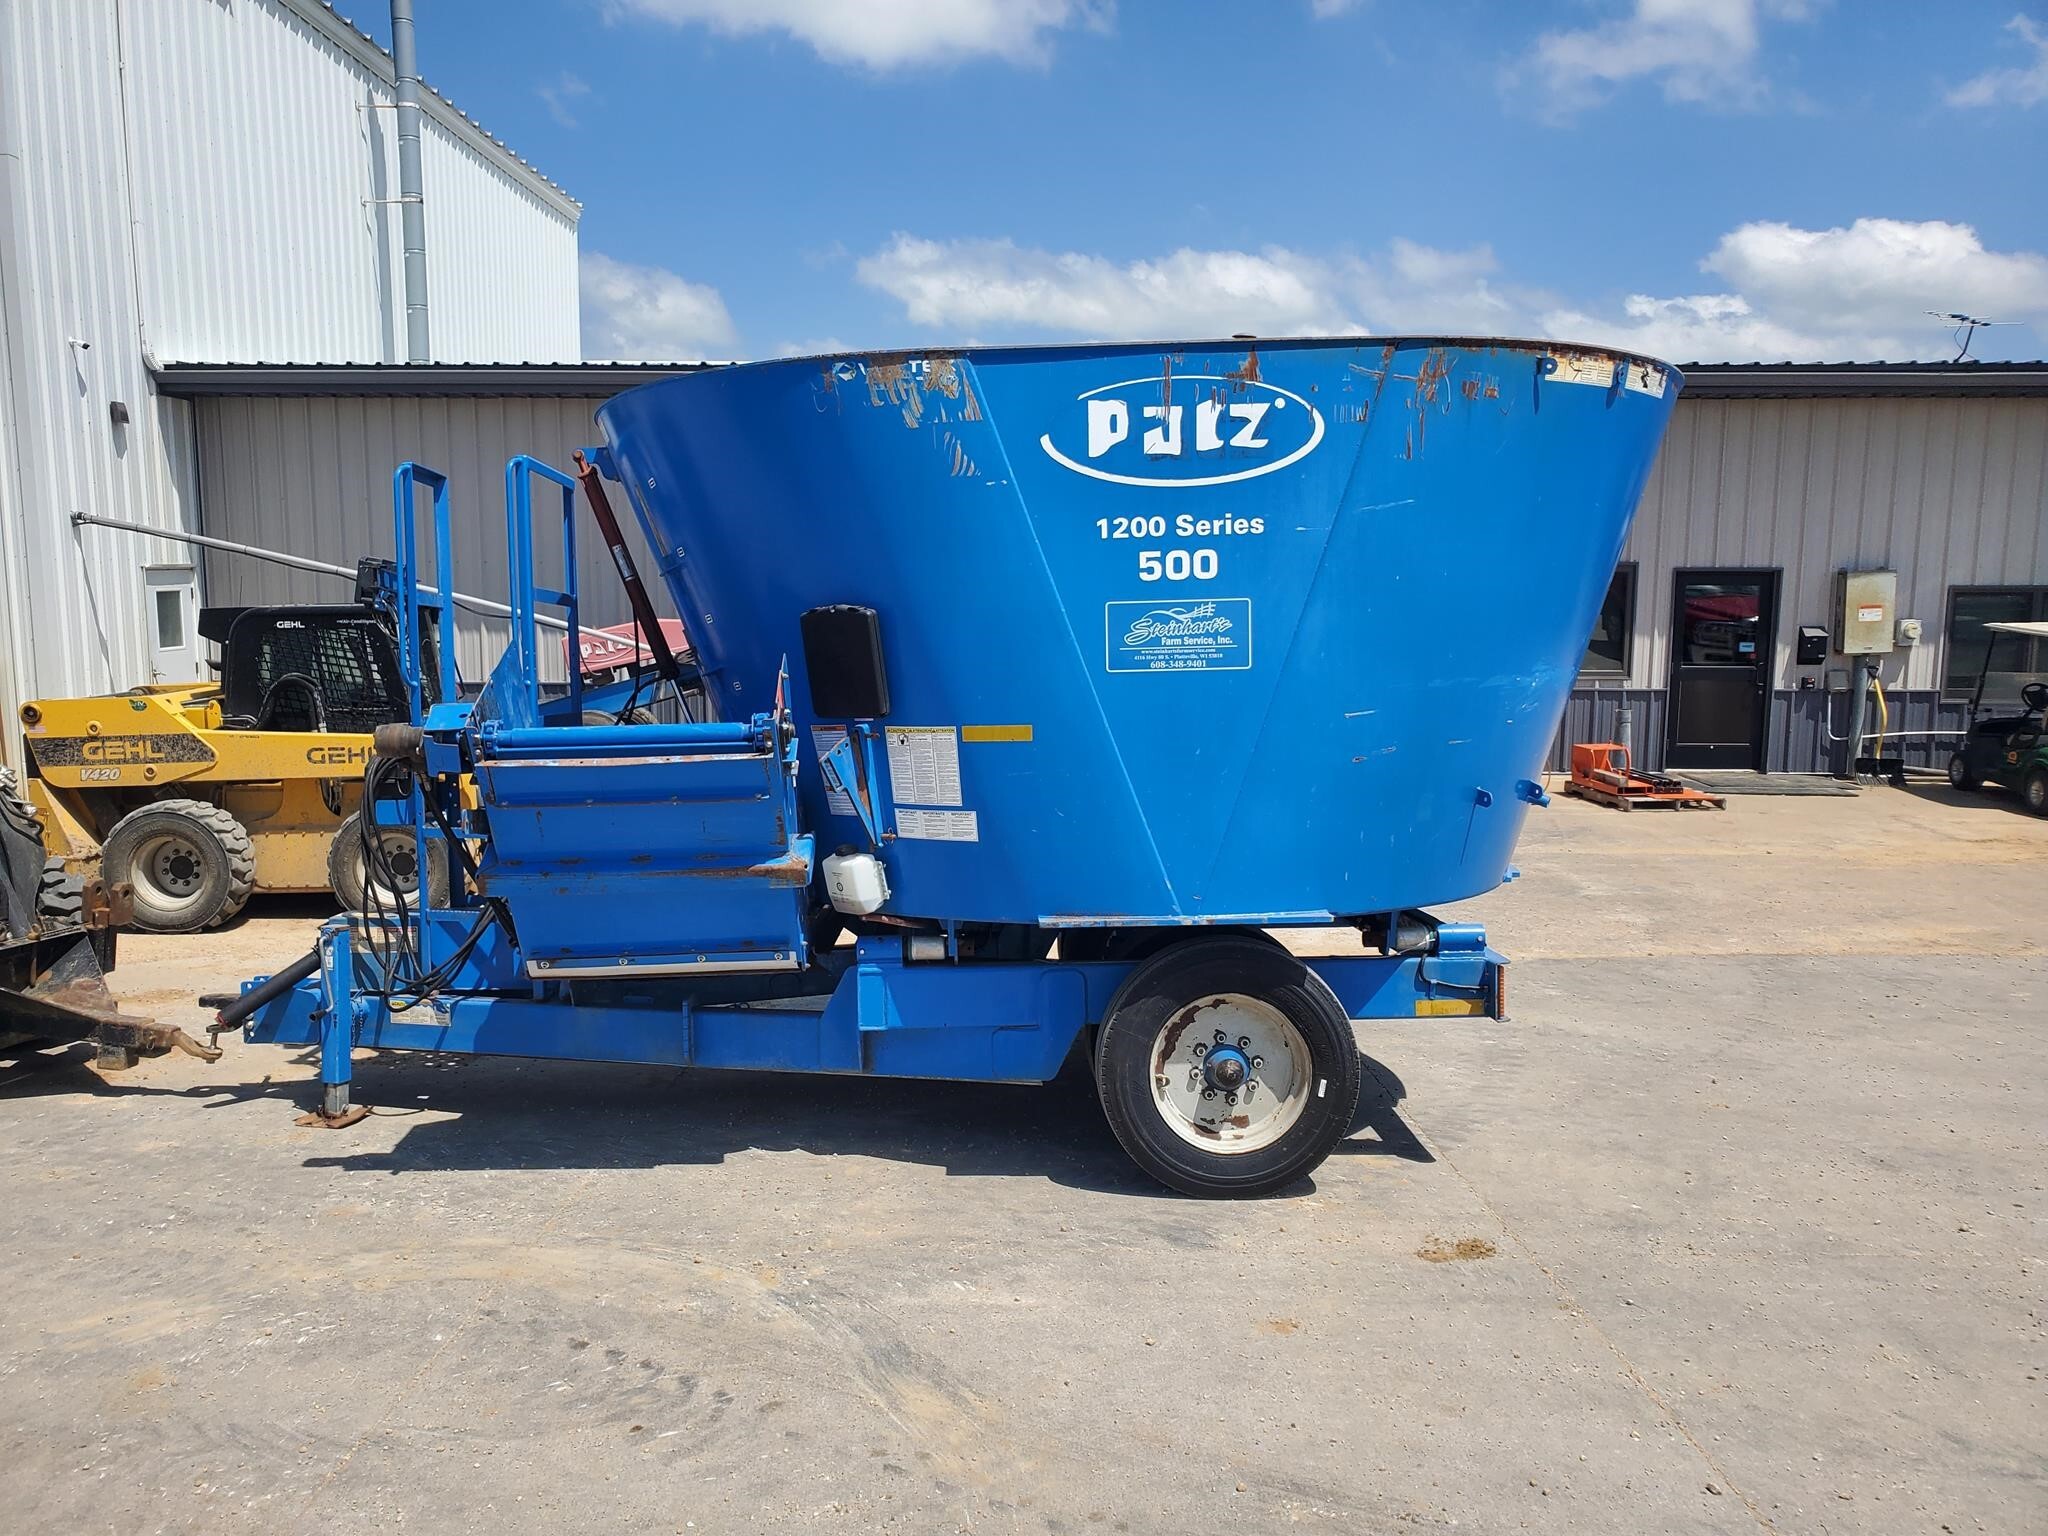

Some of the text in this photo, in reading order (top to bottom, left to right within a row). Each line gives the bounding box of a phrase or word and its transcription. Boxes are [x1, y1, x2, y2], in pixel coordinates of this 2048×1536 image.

[1096, 512, 1265, 539] 1200 Series
[1138, 549, 1218, 582] 500
[276, 620, 306, 629] GEHL
[1124, 617, 1232, 646] Steinhart's
[1161, 635, 1233, 646] Farm Service, Inc.
[1150, 659, 1207, 669] 608-348-9401
[82, 739, 165, 760] GEHL
[80, 767, 121, 781] V420
